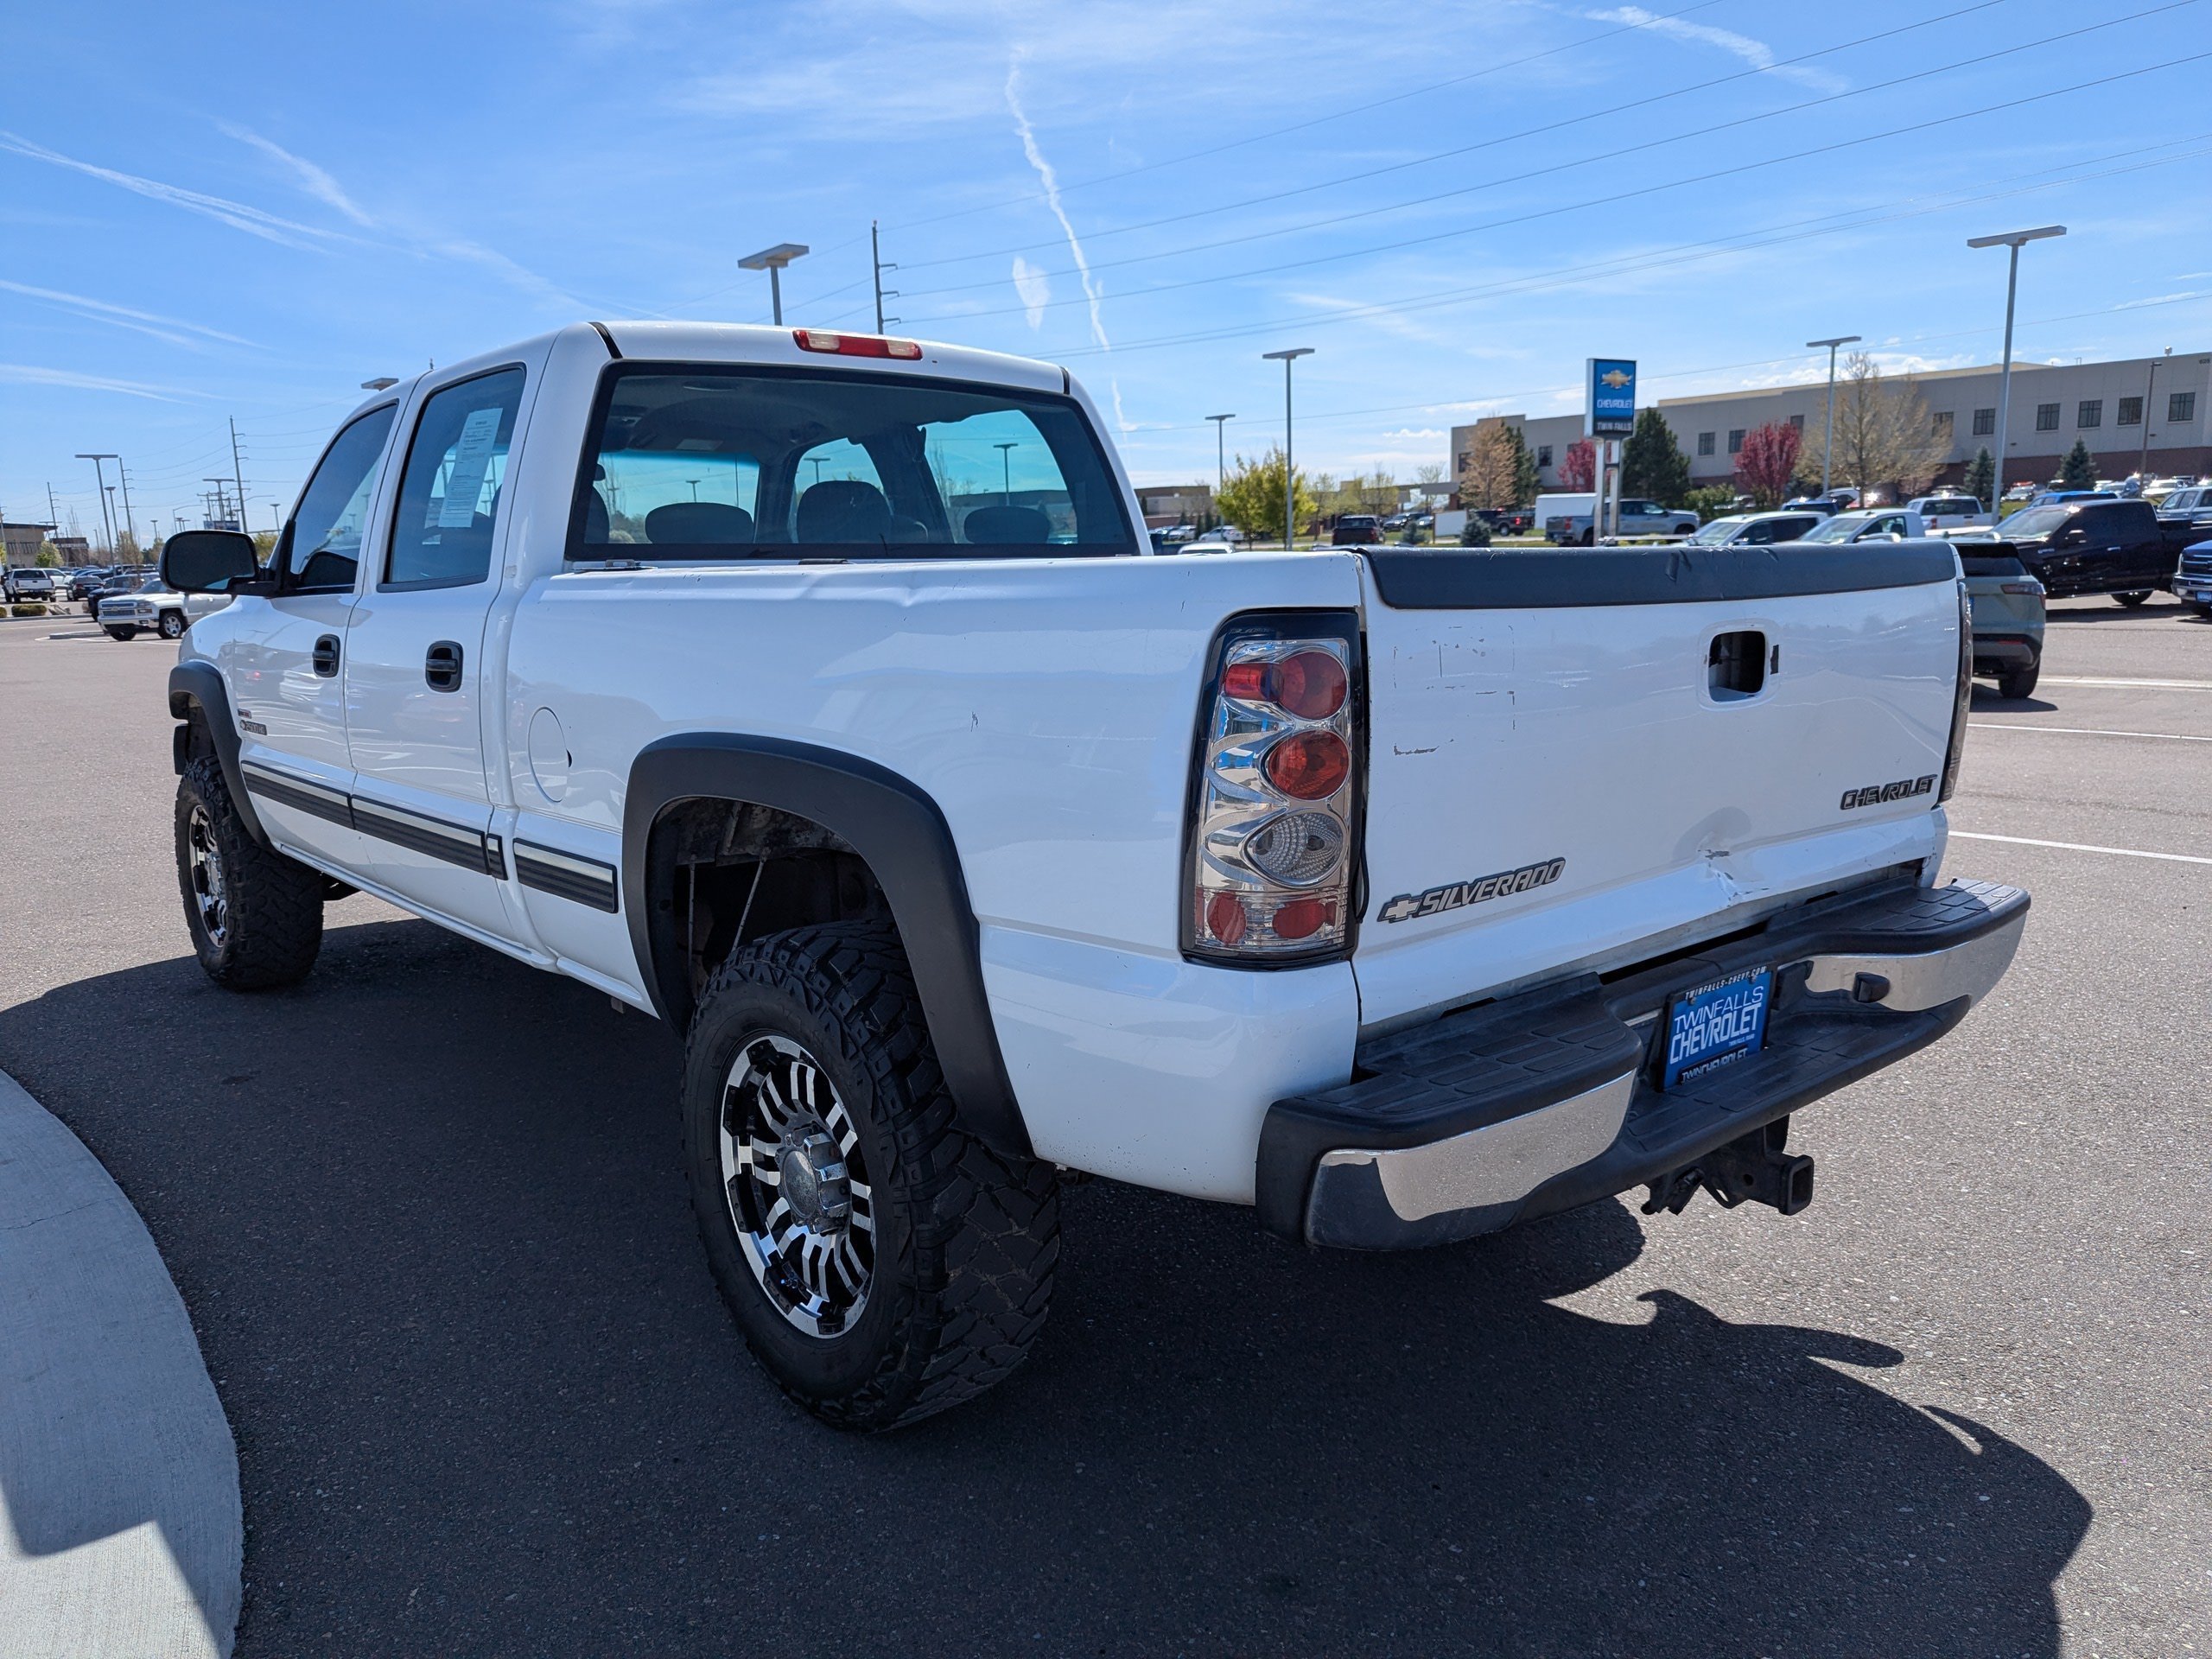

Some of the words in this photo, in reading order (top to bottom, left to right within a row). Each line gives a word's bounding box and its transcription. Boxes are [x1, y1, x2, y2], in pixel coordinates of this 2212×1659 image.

[1597, 399, 1632, 409] CHEVROLET
[1597, 422, 1612, 430] TWIN
[1614, 422, 1632, 431] FALLS
[1840, 774, 1938, 810] CHEVROLET
[1417, 857, 1567, 917] SILVERADO
[1669, 1002, 1762, 1065] CHEVROLET
